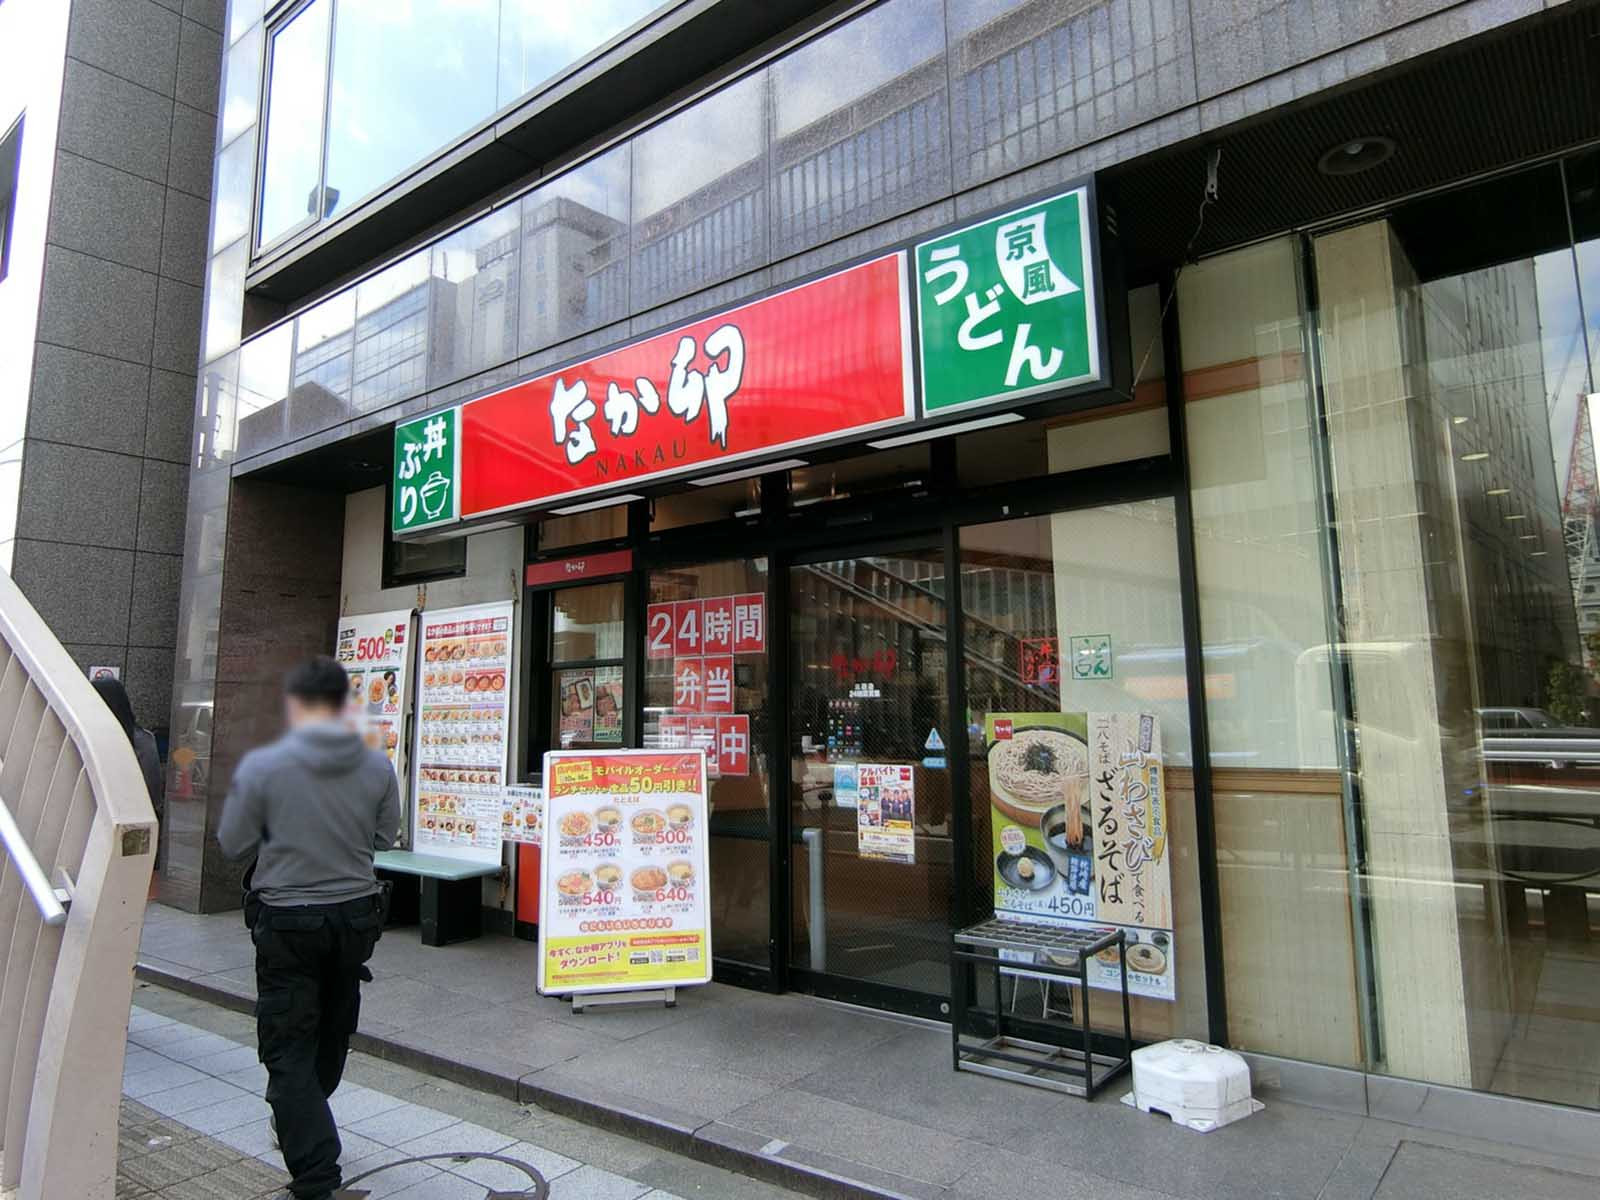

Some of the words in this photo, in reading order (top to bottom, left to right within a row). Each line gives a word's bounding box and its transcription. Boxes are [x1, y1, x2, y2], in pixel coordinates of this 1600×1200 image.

[1004, 224, 1055, 299] 京風
[925, 245, 1064, 387] うどん
[549, 324, 746, 466] なか卯
[595, 439, 688, 478] NAKAU
[650, 604, 763, 651] 24時間
[676, 667, 731, 705] 弁当
[1097, 718, 1111, 765] 二八そば
[860, 766, 896, 777] アルバイト
[583, 833, 622, 847] 450円
[656, 831, 694, 844] 500円
[1096, 767, 1124, 905] ざるそば
[583, 891, 622, 906] 540円
[656, 888, 695, 902] 640円
[1048, 896, 1094, 917] 450円
